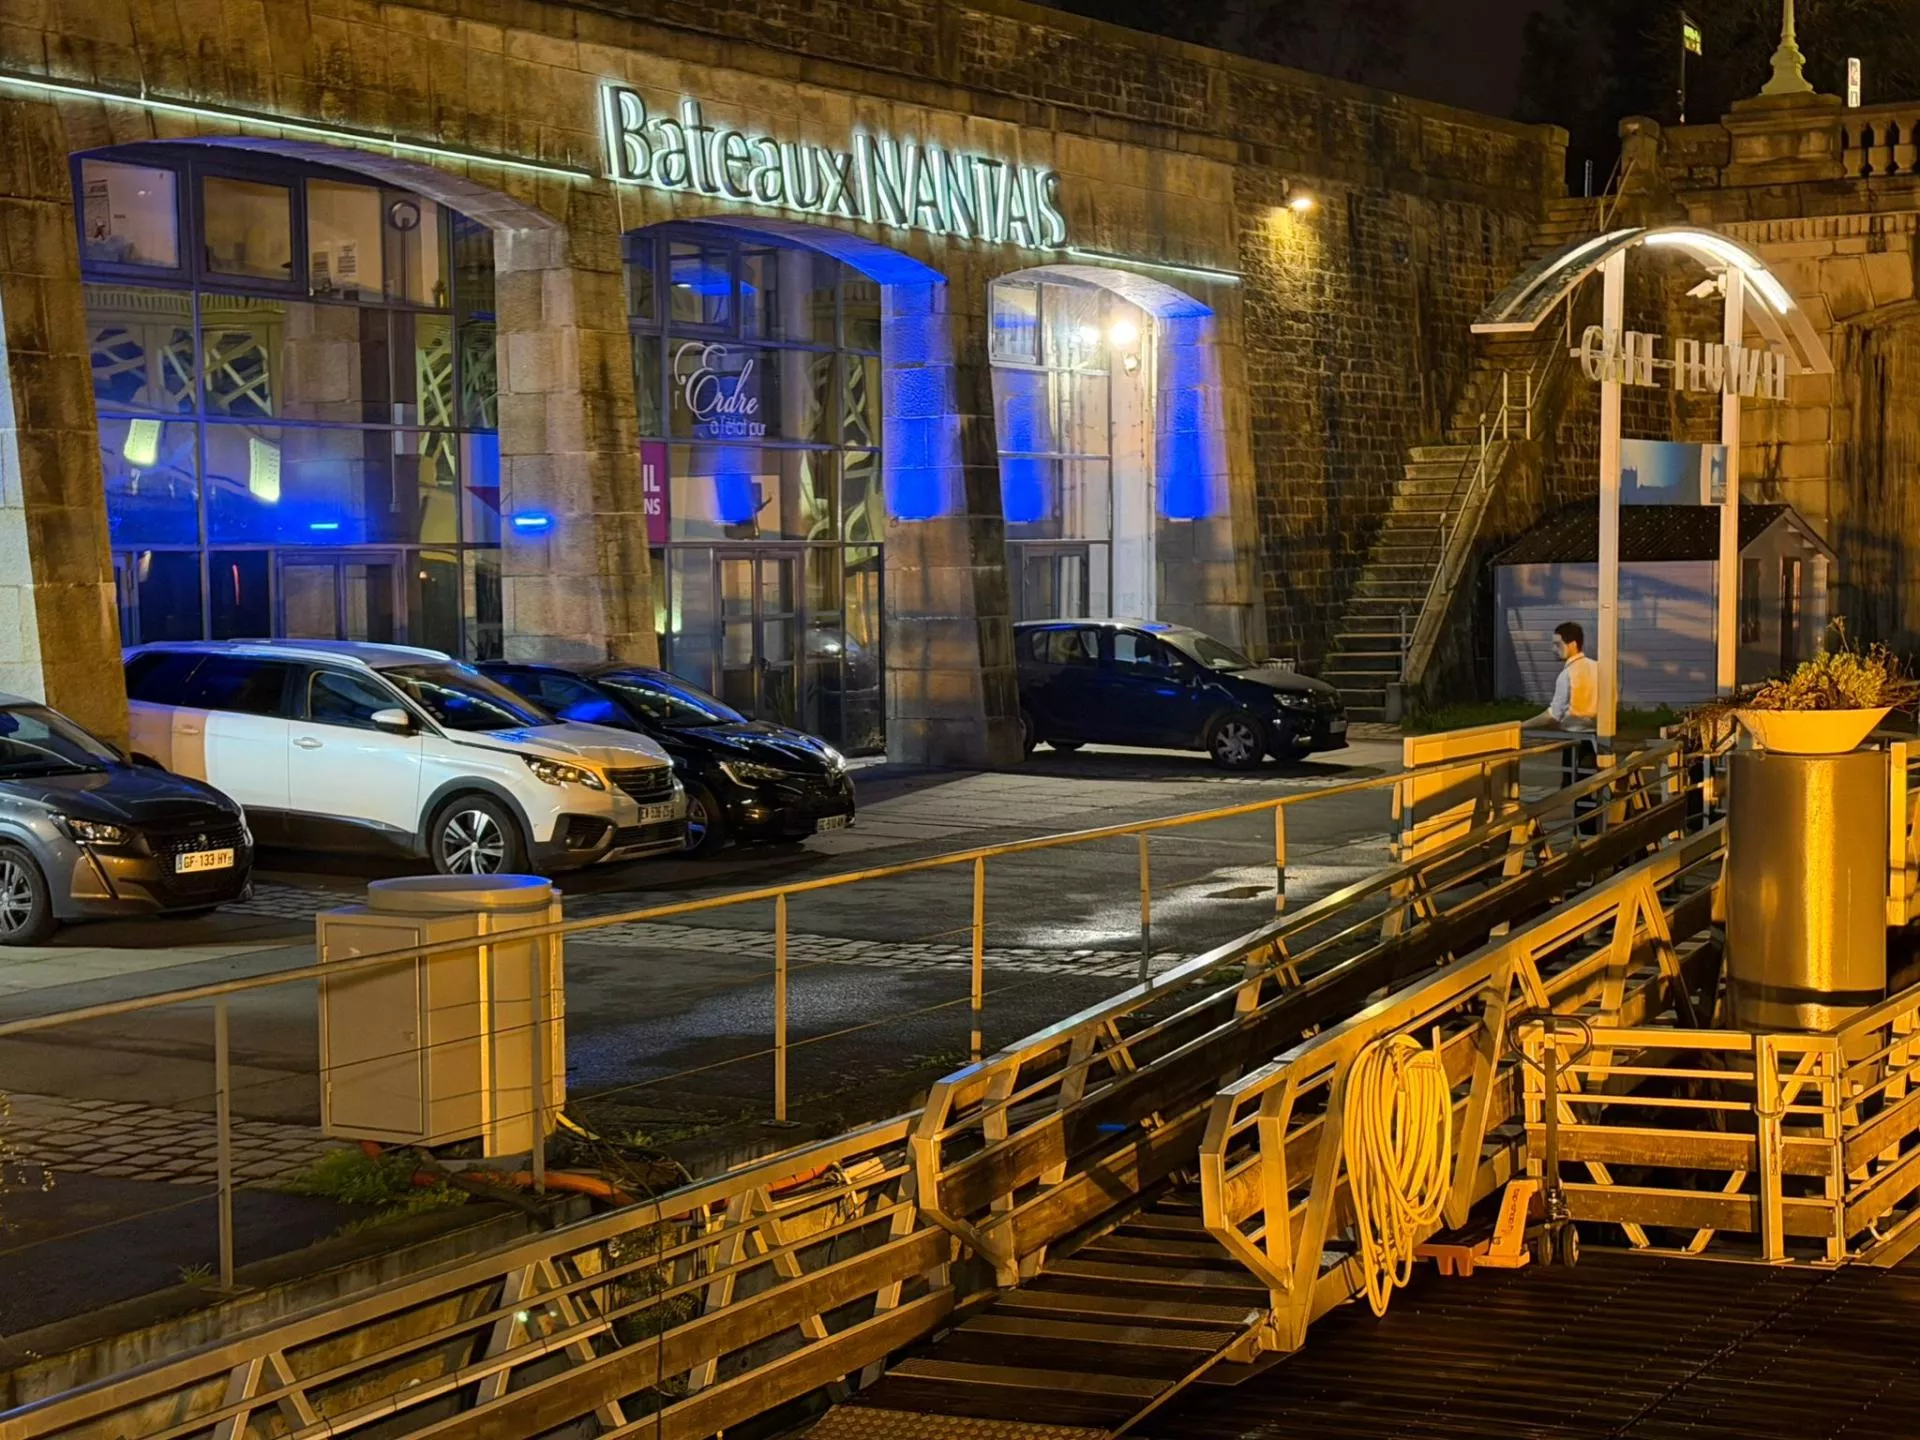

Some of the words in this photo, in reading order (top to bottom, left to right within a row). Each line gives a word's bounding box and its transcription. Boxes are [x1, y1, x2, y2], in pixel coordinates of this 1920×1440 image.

[600, 83, 859, 218] Bateaux
[855, 132, 1067, 248] NANTAIS
[1580, 325, 1662, 389] GARE
